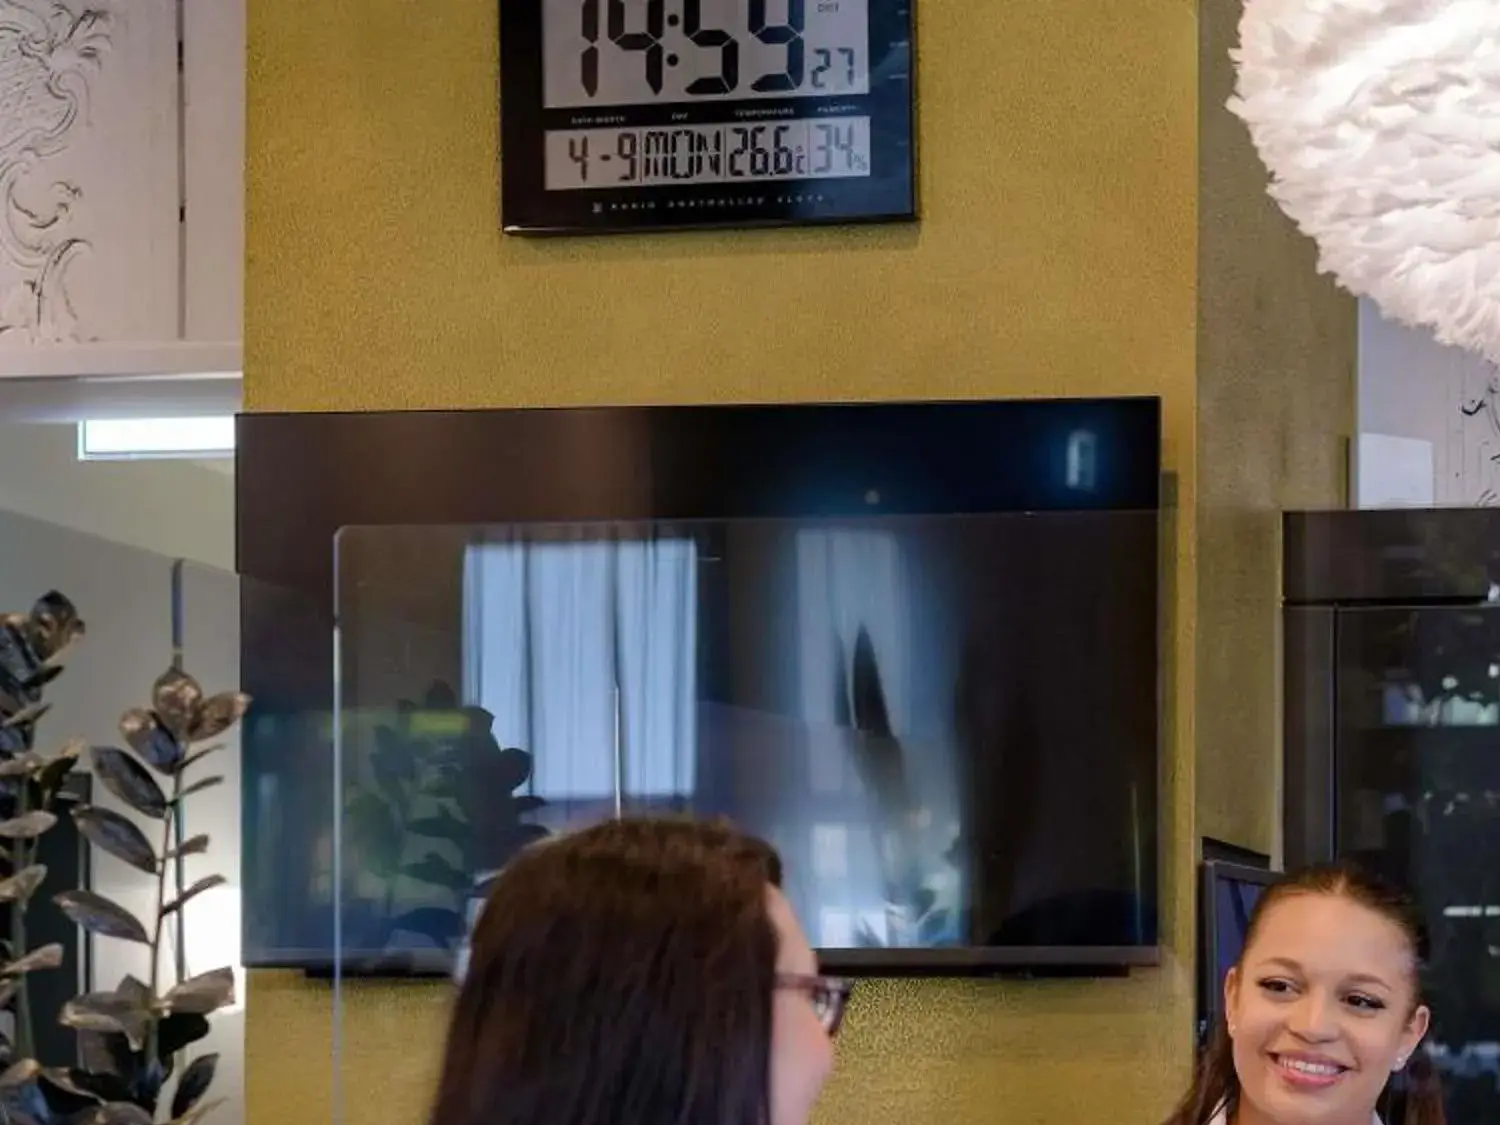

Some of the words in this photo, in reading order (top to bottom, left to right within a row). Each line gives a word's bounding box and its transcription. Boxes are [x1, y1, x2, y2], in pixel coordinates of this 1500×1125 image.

[581, 0, 804, 97] 14:59
[811, 47, 854, 88] 27
[644, 130, 721, 178] MON
